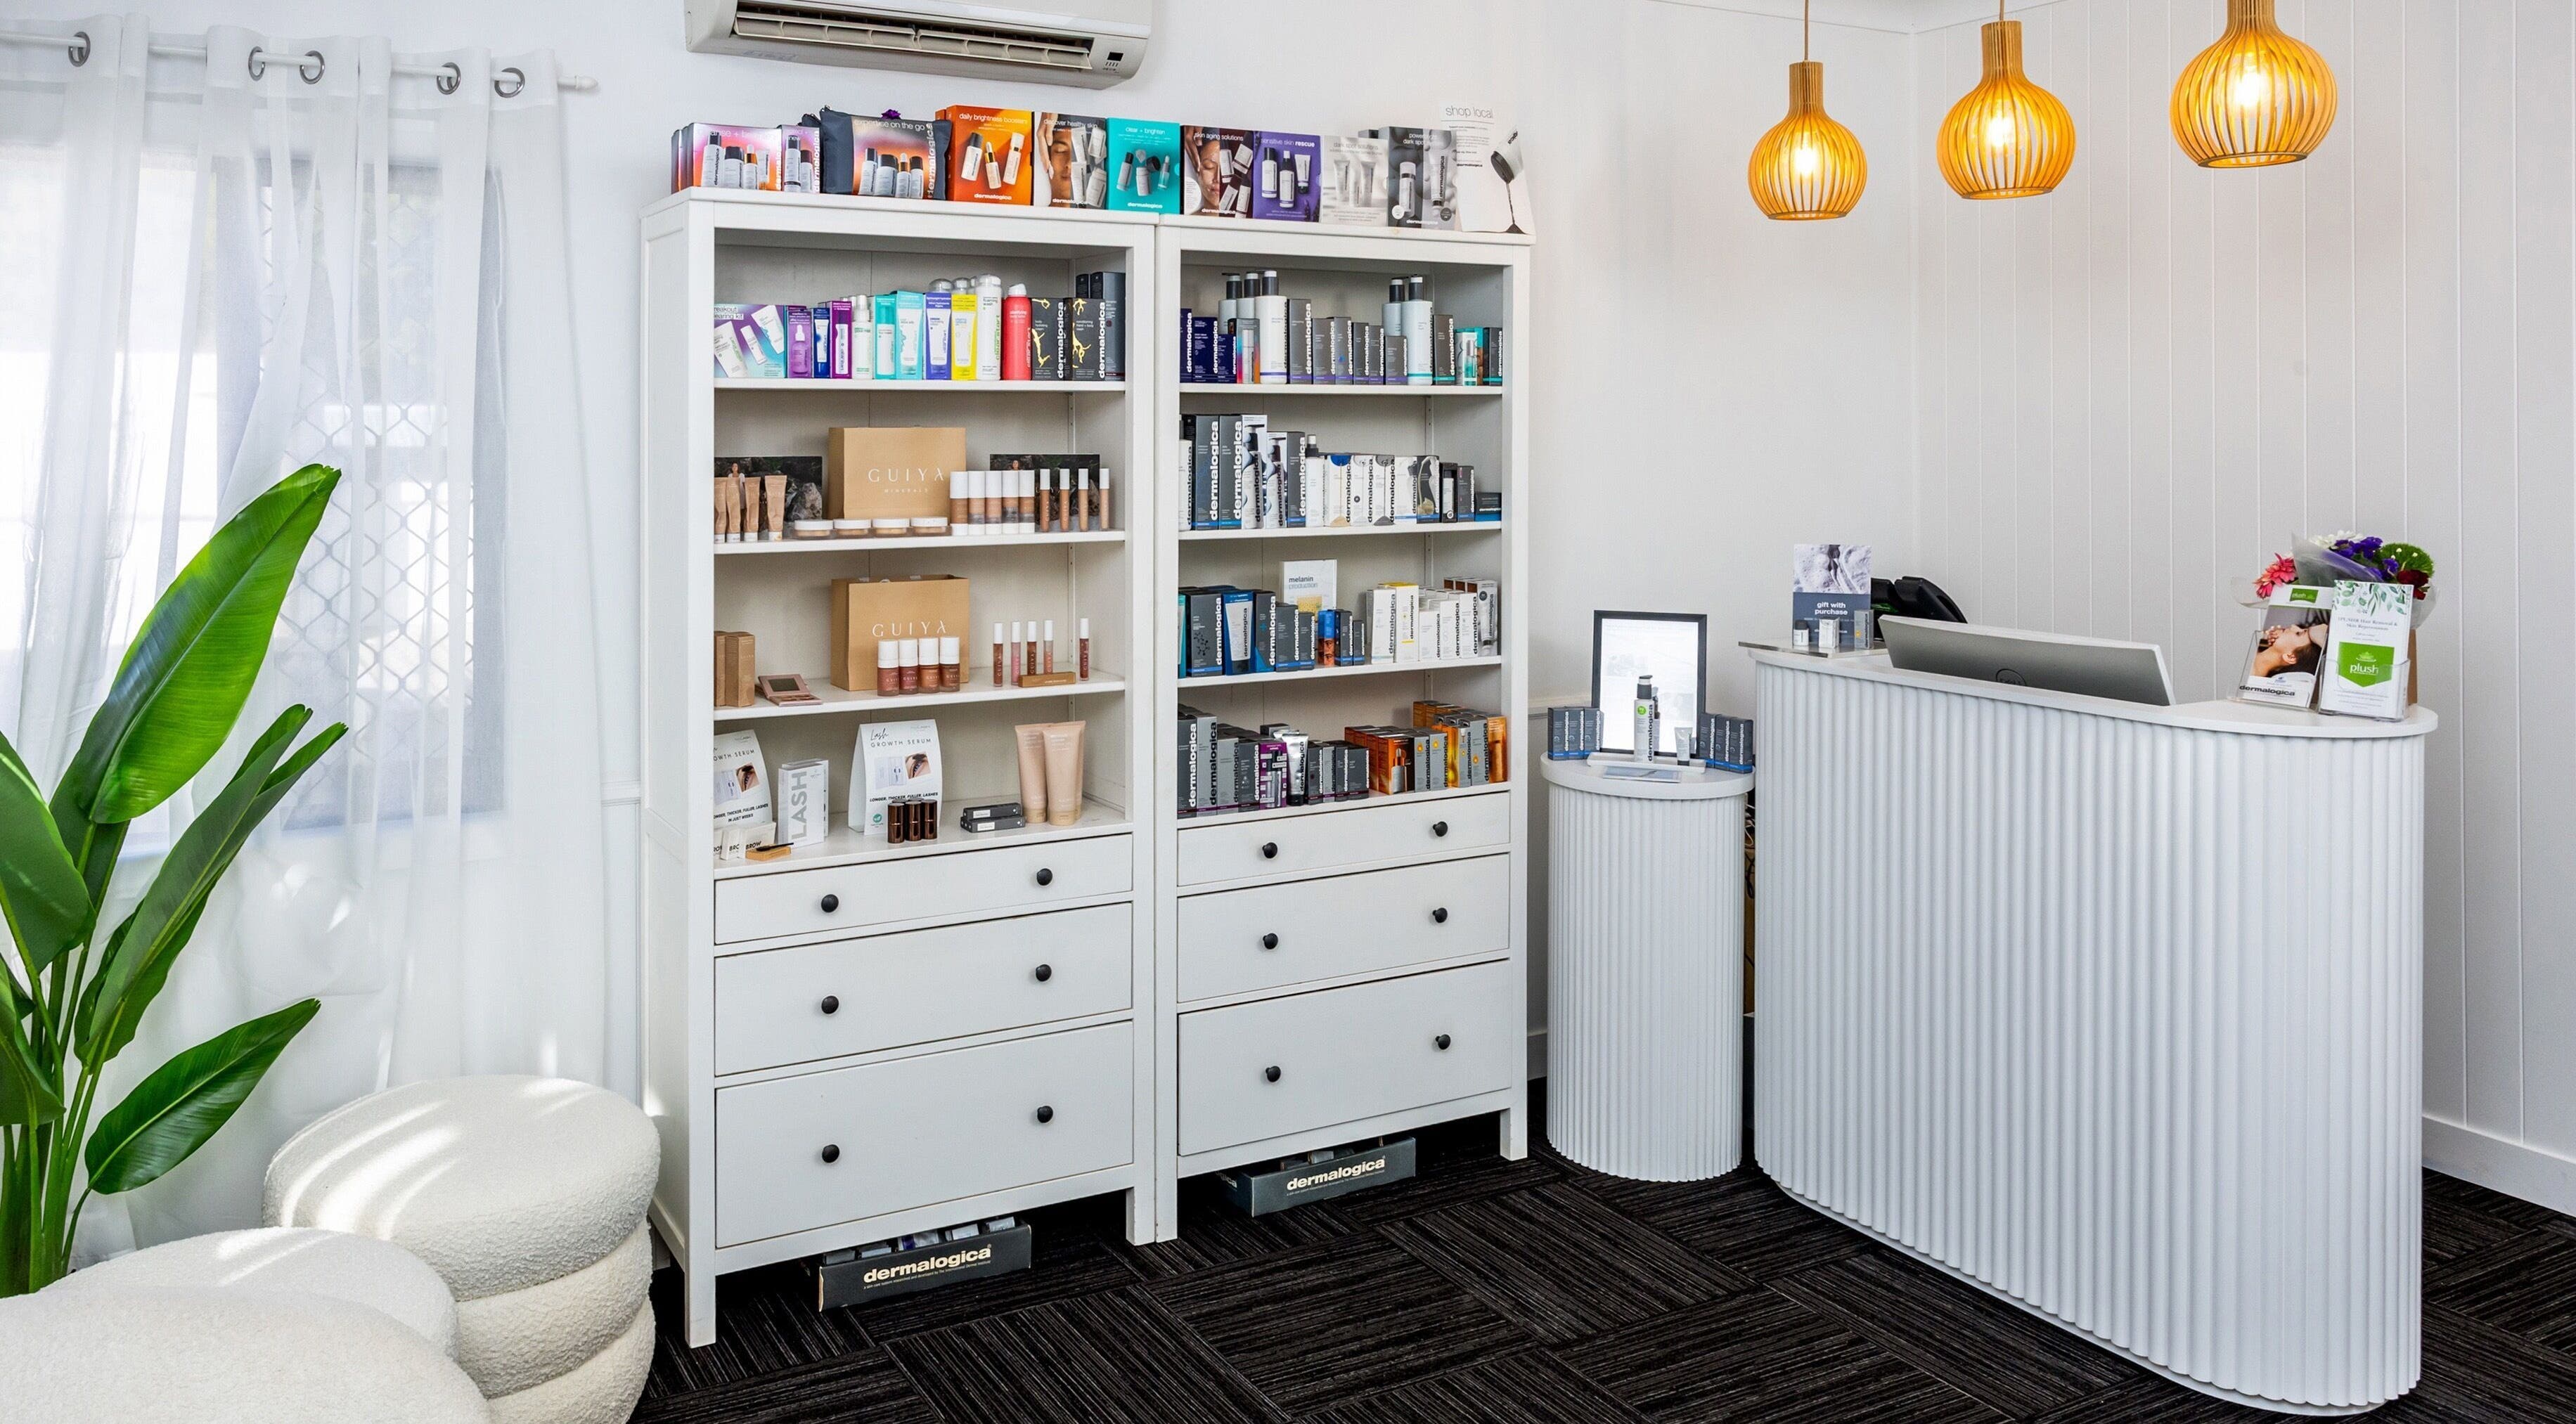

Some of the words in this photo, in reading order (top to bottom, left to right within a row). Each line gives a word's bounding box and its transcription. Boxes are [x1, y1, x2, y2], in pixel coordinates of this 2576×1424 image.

[973, 114, 1003, 123] brightness
[1445, 105, 1471, 117] shop
[1473, 106, 1494, 119] local
[1209, 421, 1219, 521] dermalogica
[1233, 421, 1242, 519] dermalogica
[2350, 663, 2379, 675] plush
[2239, 685, 2295, 697] dermalogica
[871, 739, 903, 748] GROWTH
[714, 753, 732, 762] OWTH
[735, 749, 755, 758] SERUM
[1189, 723, 1197, 808] dermalogica
[791, 771, 808, 840] LASH
